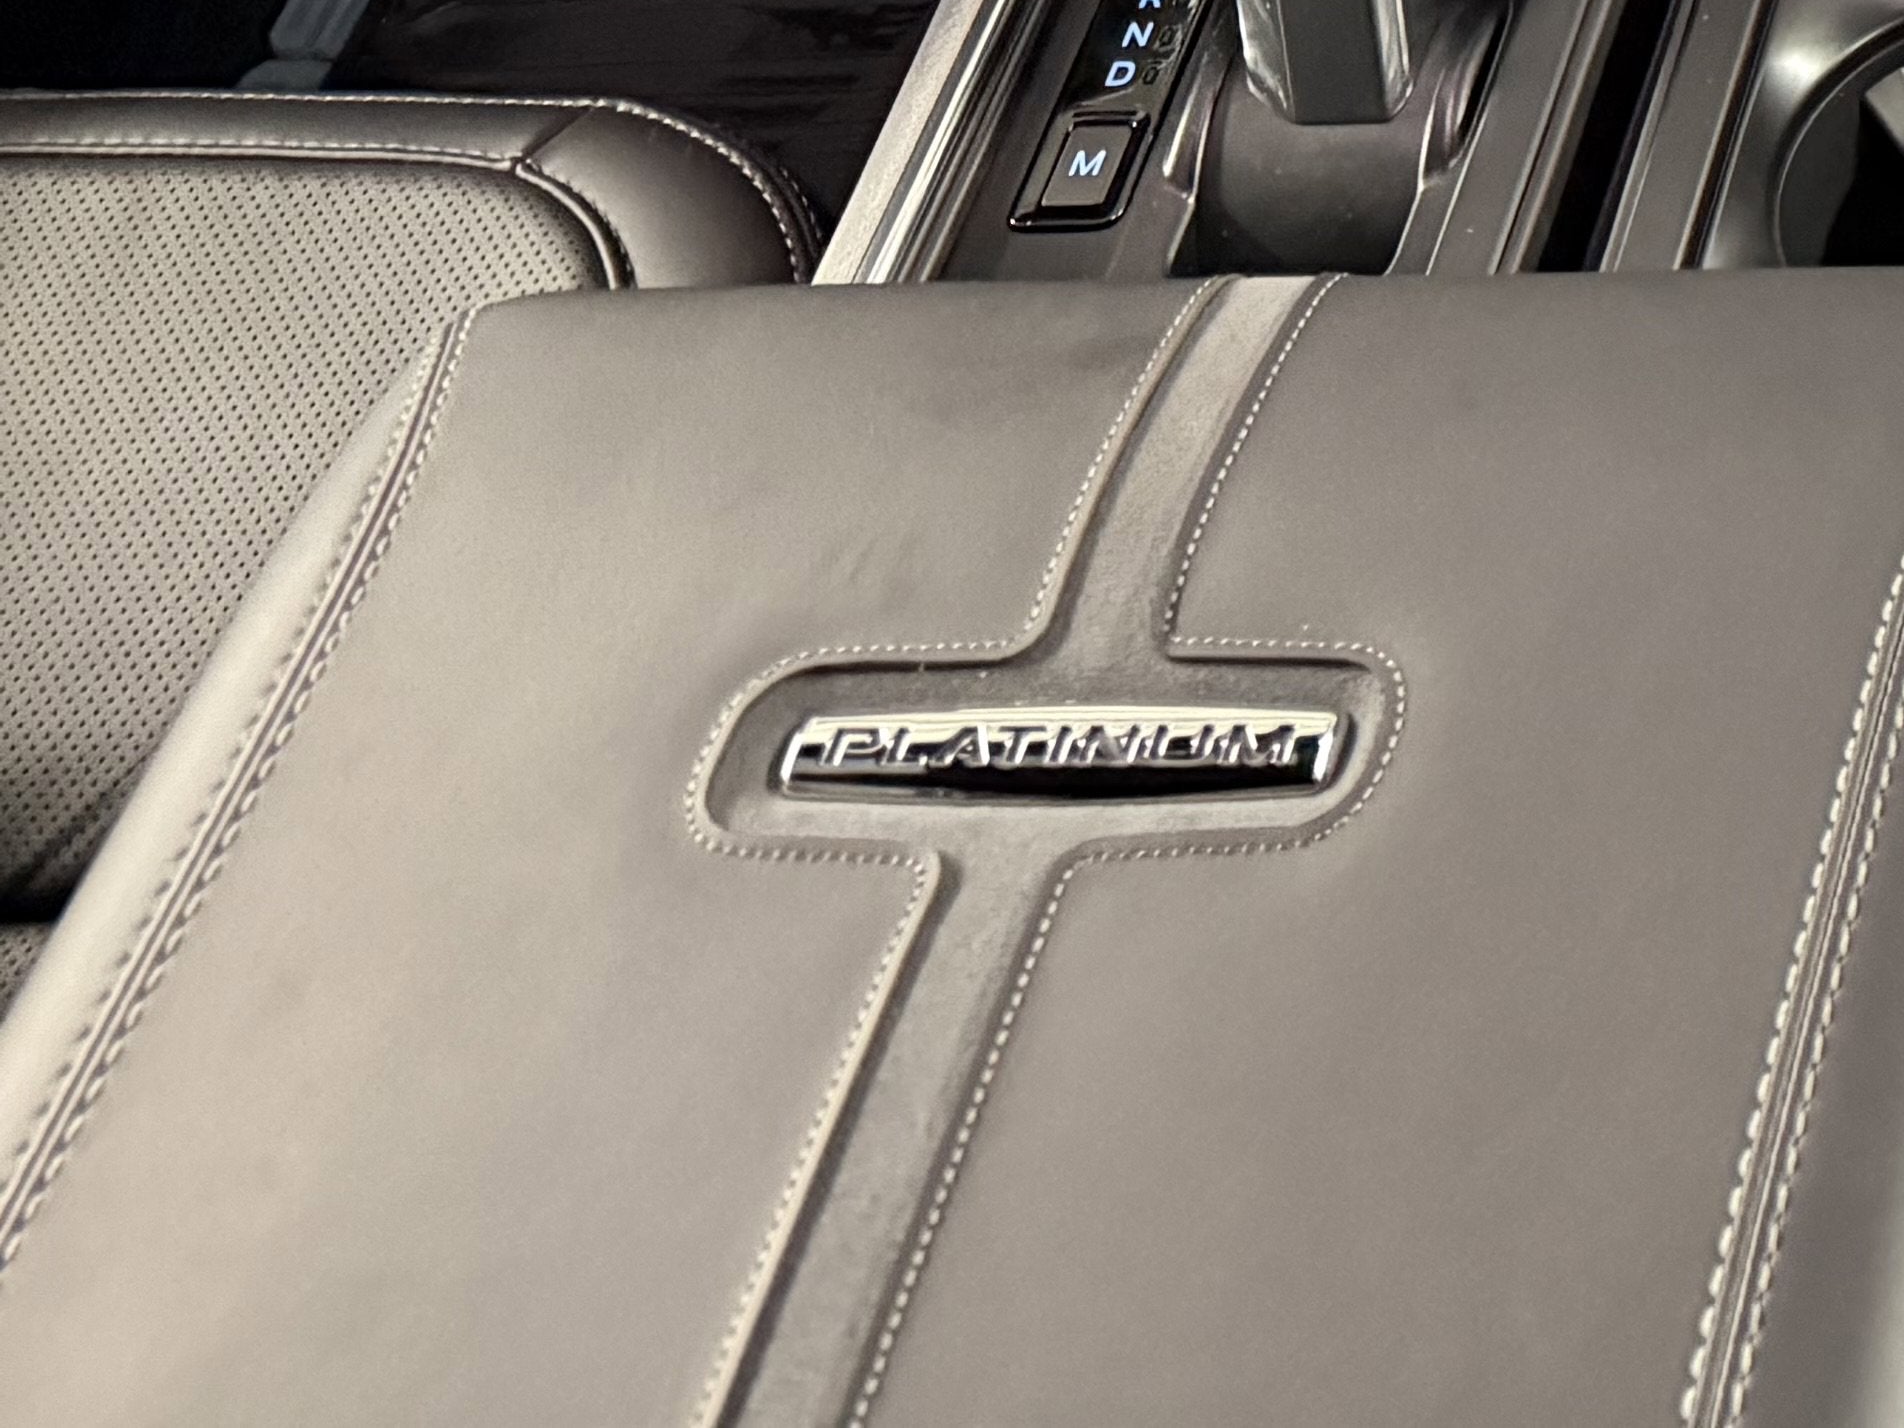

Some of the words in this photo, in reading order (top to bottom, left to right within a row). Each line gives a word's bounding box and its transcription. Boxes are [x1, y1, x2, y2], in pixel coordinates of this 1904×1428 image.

[1121, 20, 1155, 48] N
[1104, 61, 1136, 88] D
[1068, 148, 1107, 178] M
[813, 721, 1306, 769] PLATINUM
